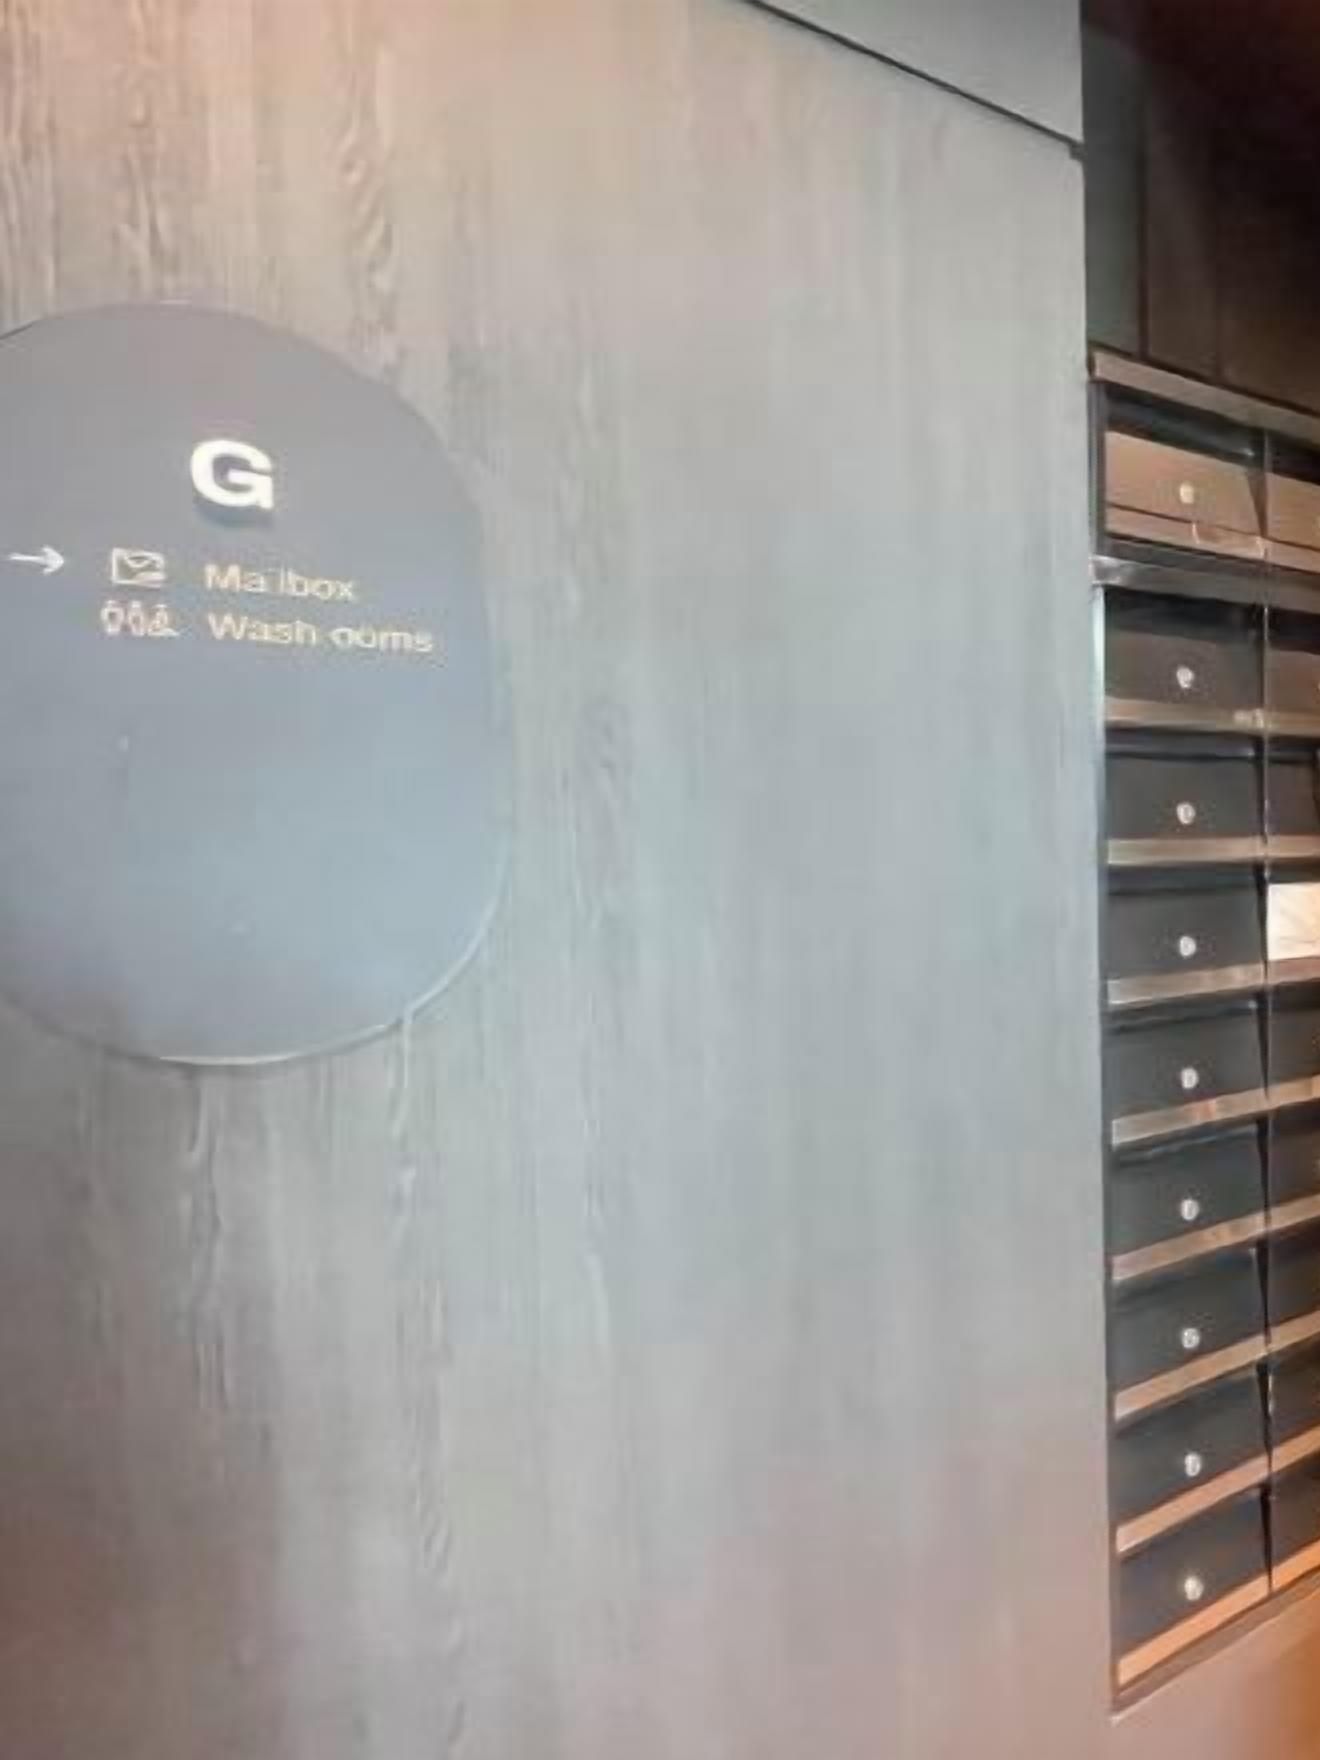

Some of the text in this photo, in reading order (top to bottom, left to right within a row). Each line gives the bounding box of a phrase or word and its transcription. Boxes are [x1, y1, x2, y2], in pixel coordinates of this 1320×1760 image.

[191, 439, 274, 508] G
[205, 564, 354, 601] Malbox
[207, 612, 433, 652] Washooms
